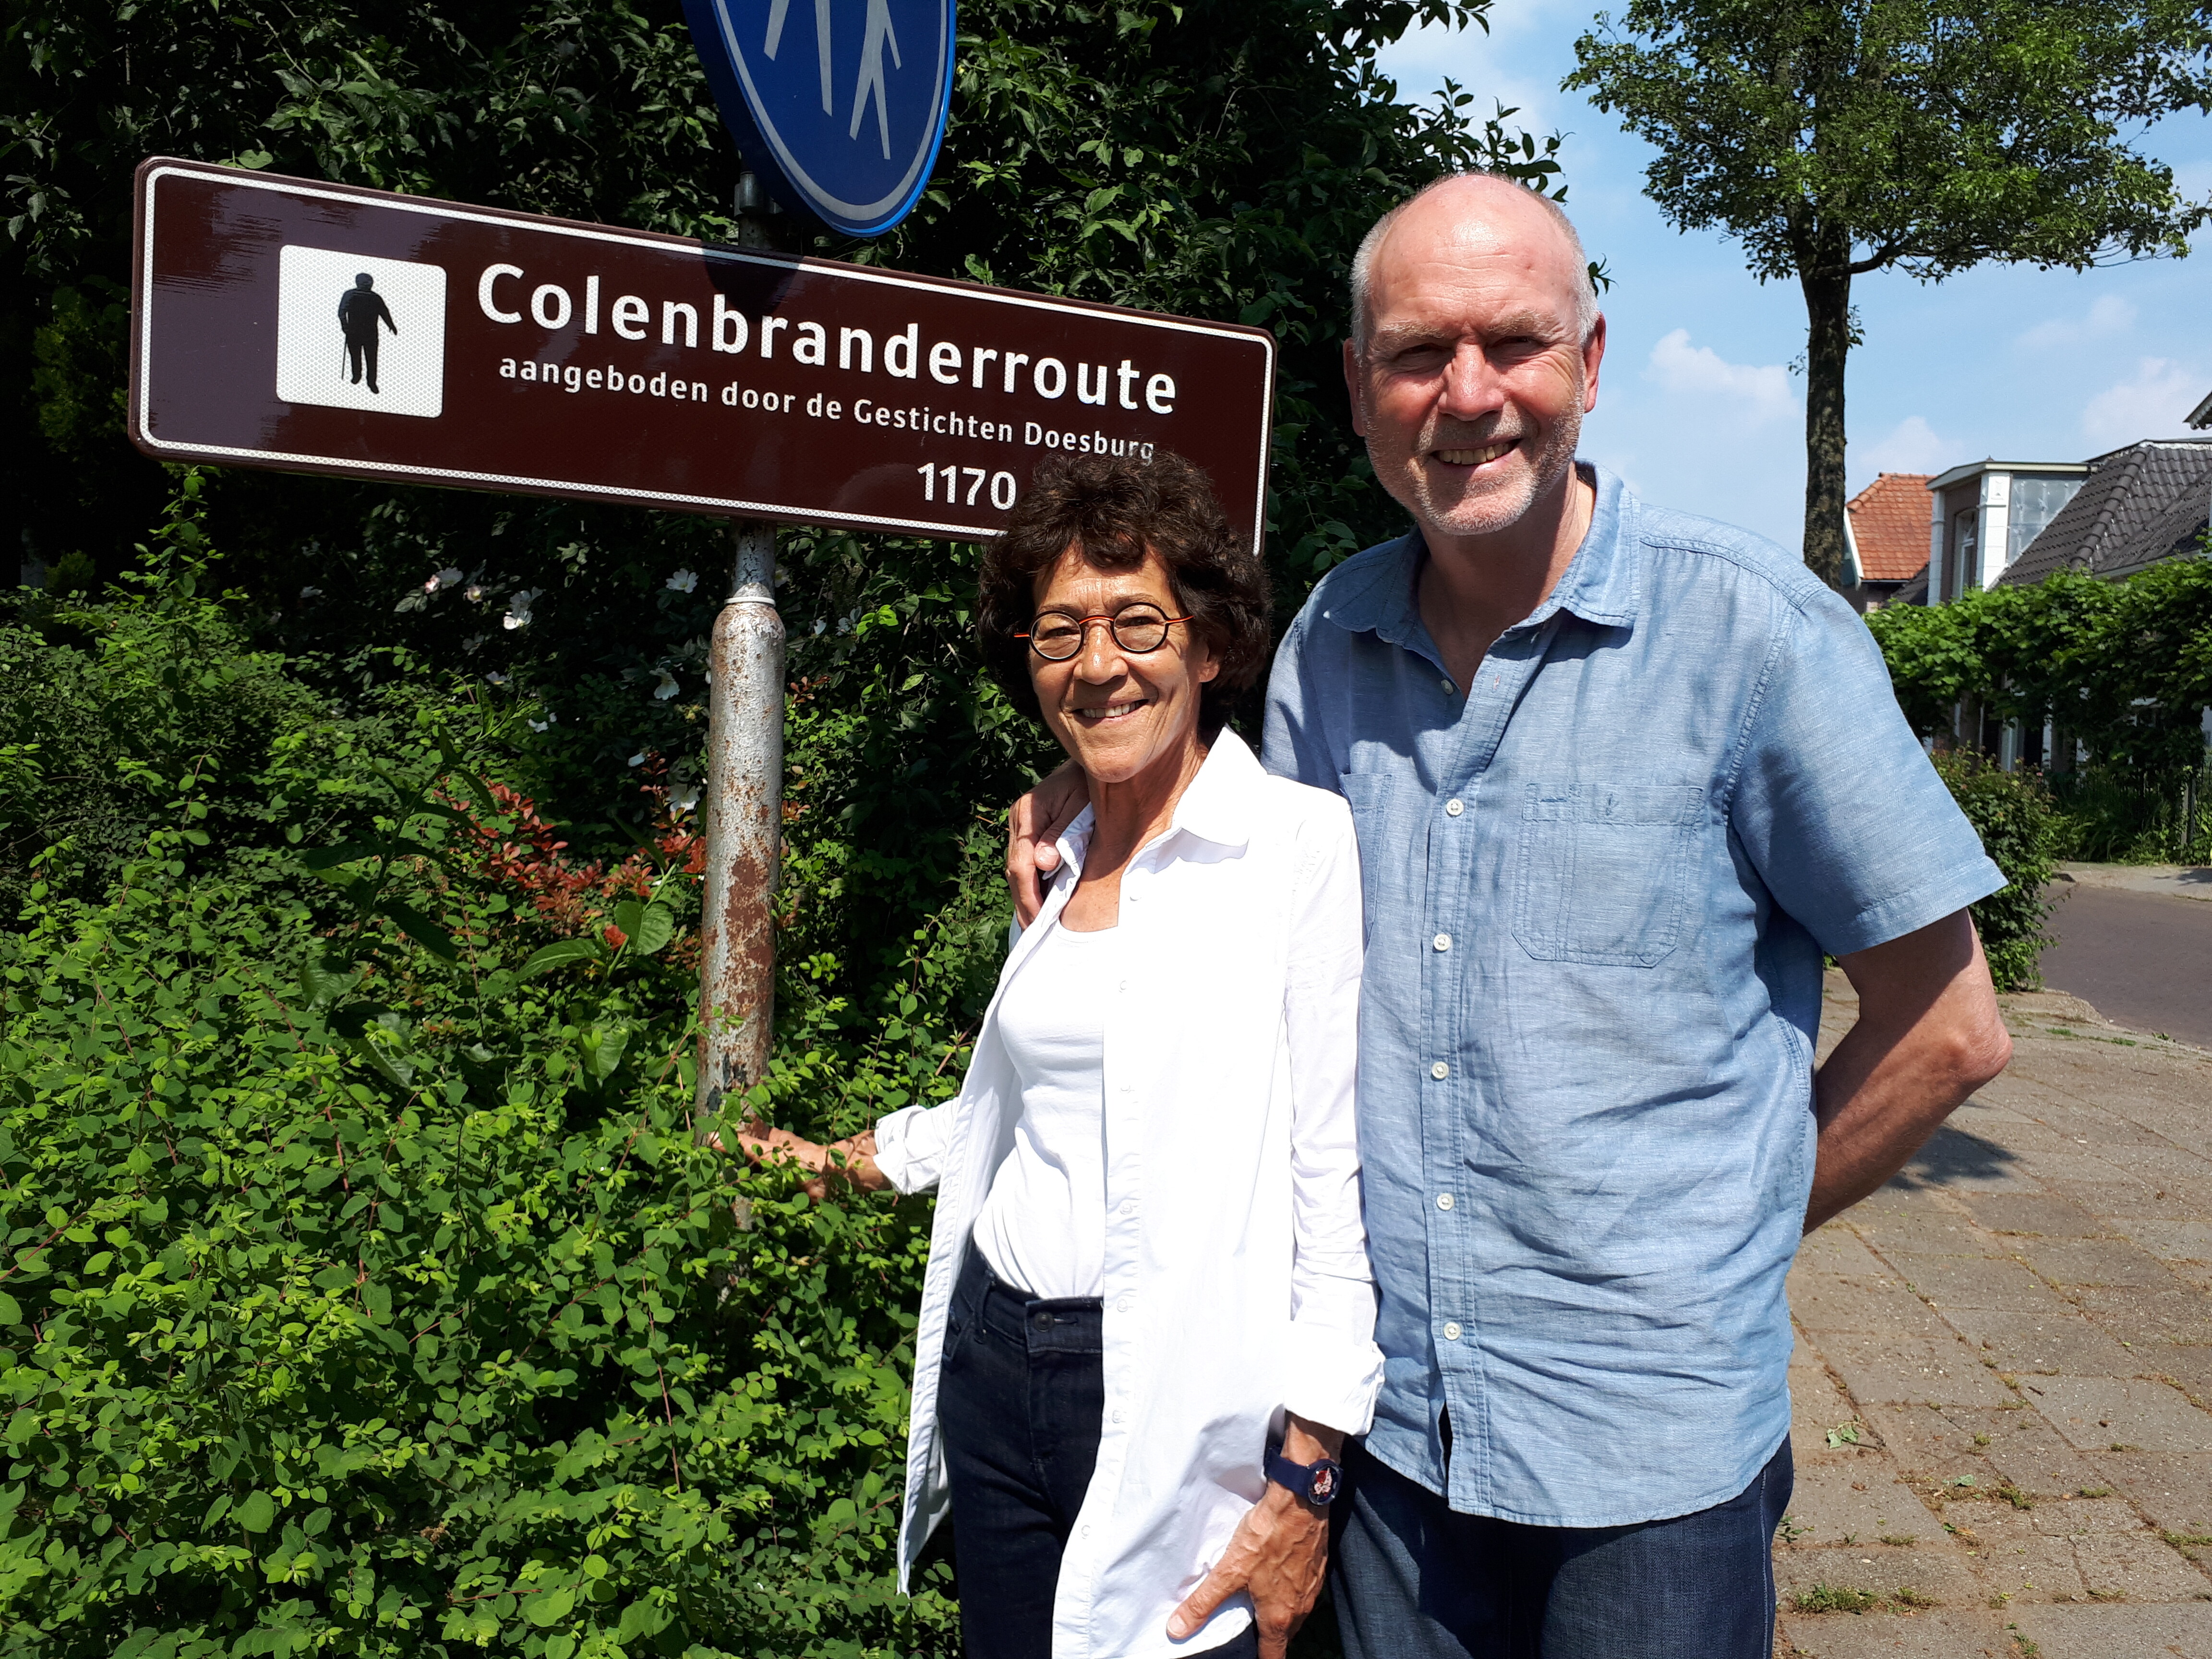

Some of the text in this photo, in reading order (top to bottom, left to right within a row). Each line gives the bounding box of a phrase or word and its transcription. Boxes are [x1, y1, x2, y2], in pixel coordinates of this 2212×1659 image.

[478, 263, 1176, 414] Colenbranderroute
[499, 358, 1154, 466] aangeboden door de Gestichten Doesburg
[917, 462, 1017, 510] 1170
